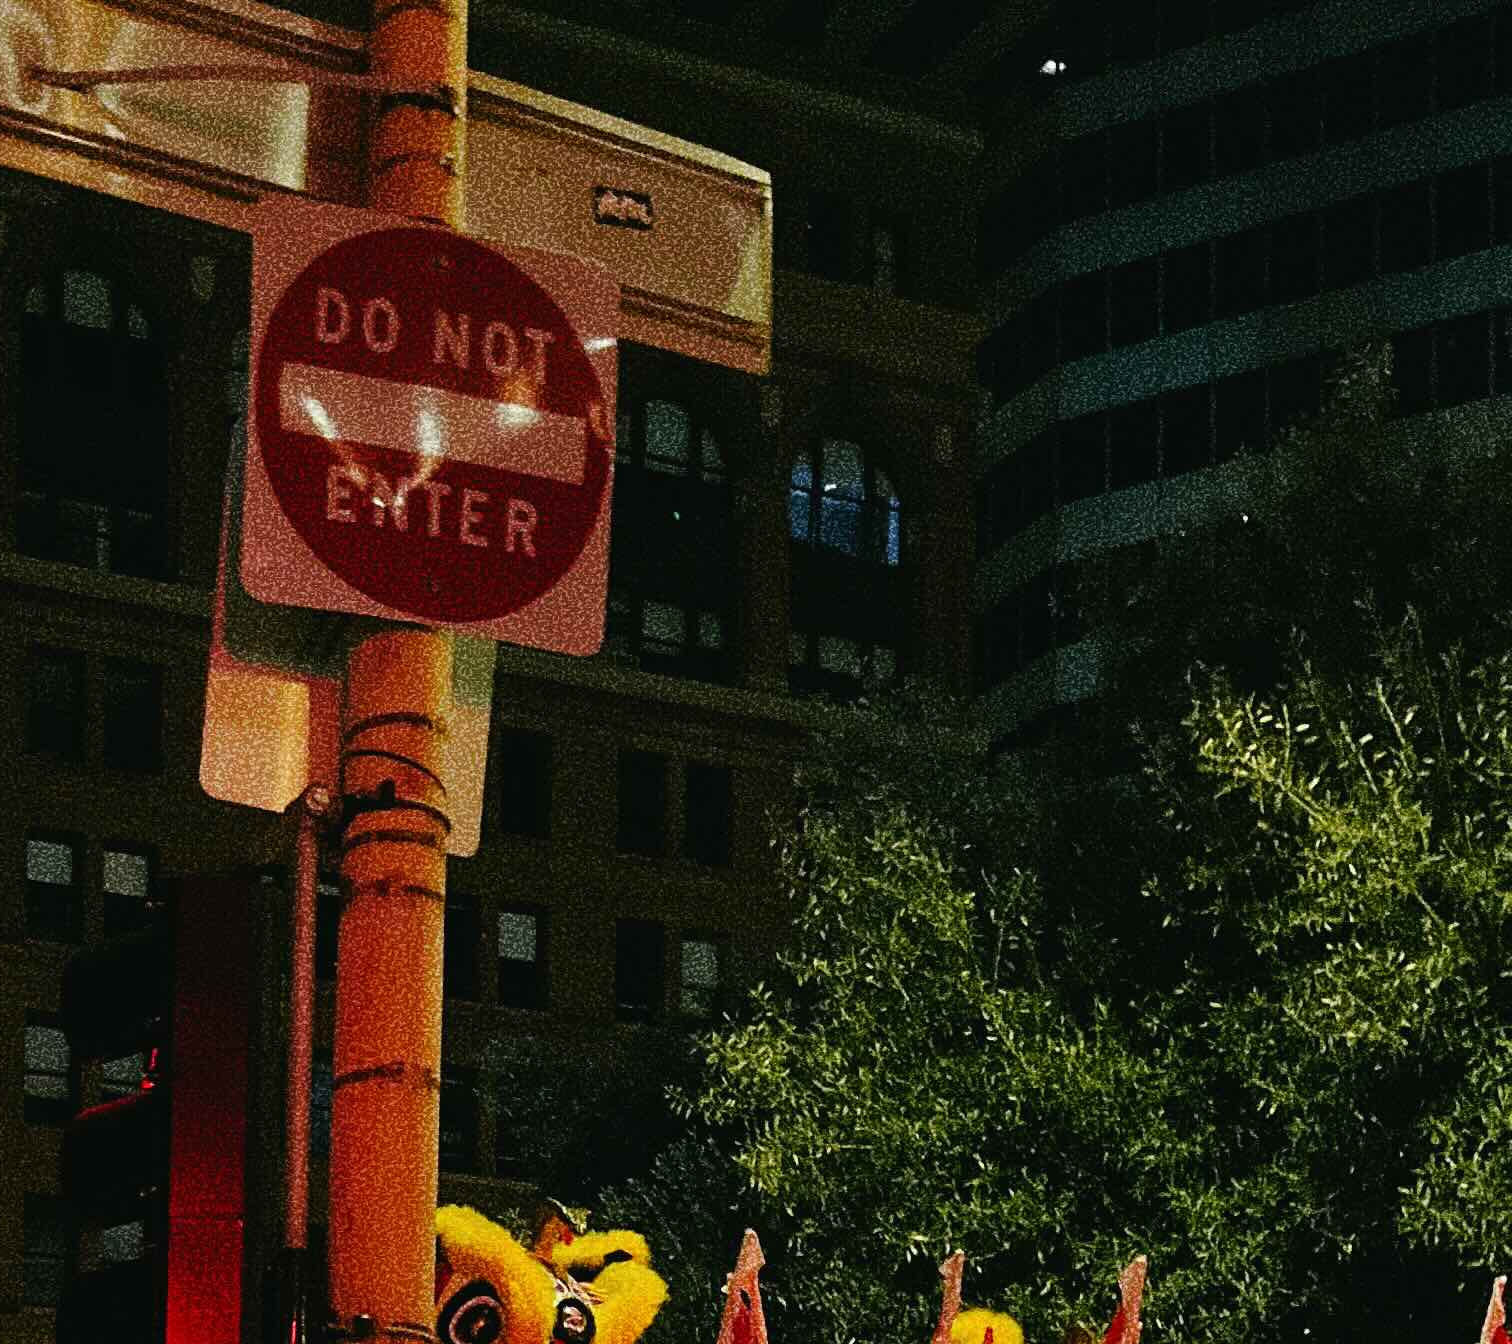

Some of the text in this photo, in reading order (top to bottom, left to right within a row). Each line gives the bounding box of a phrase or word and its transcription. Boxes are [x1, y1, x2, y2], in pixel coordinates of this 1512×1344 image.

[317, 289, 557, 381] DO NOT
[327, 469, 538, 557] ENTER
